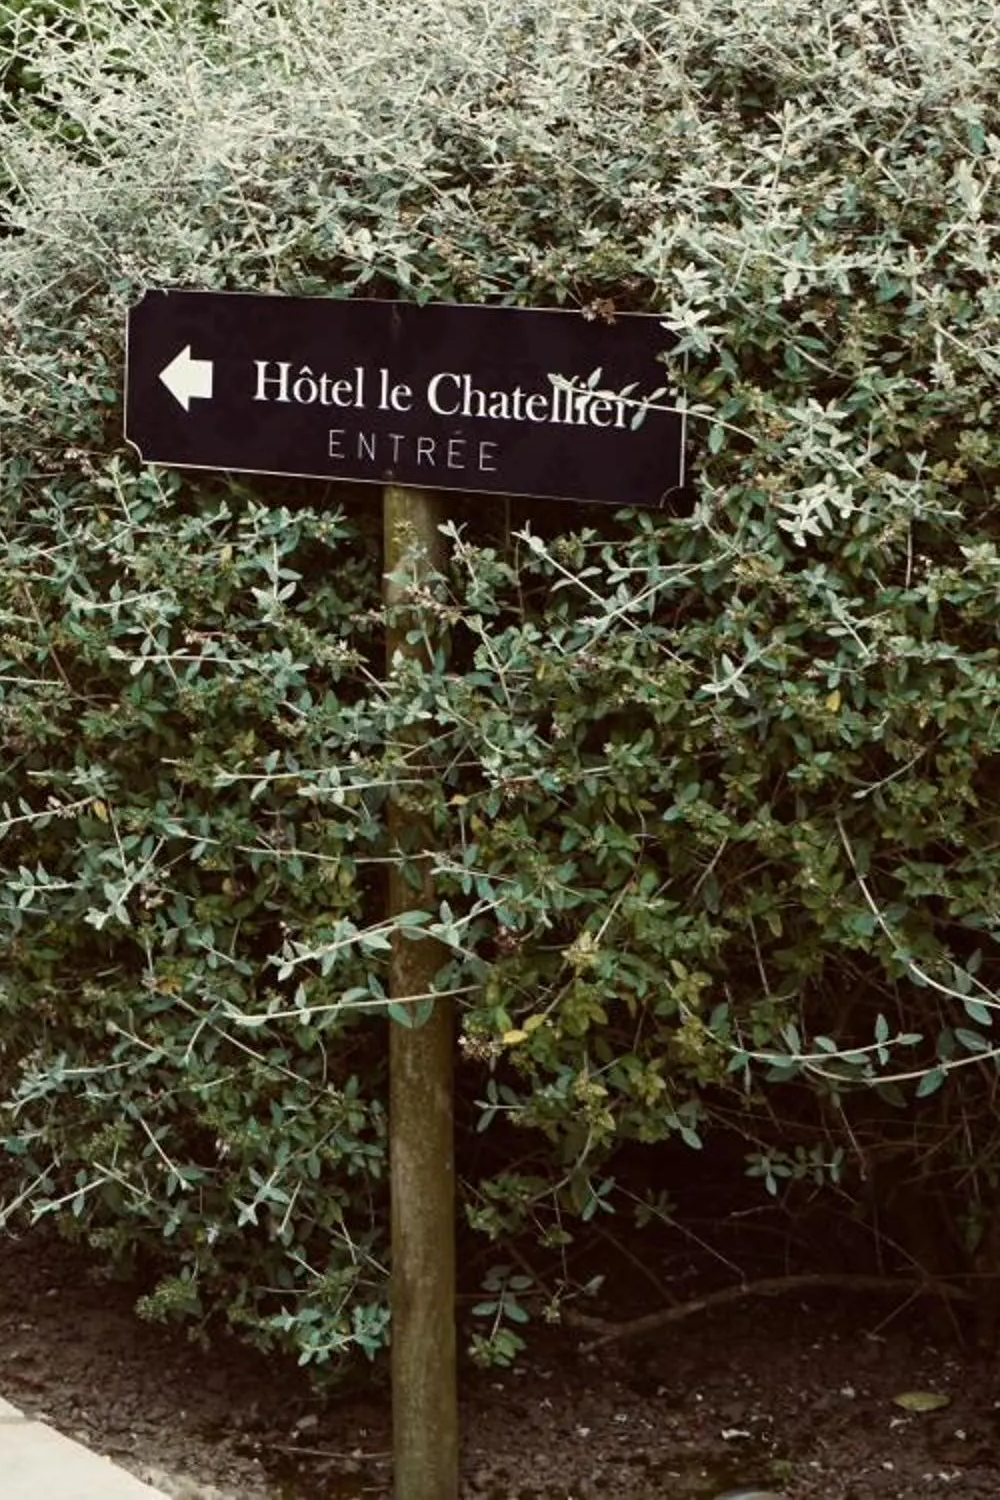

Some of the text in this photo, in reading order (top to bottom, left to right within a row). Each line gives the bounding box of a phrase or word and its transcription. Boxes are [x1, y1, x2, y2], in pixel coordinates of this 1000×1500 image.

[253, 359, 366, 408] Hôtel
[377, 368, 413, 412] le
[328, 429, 499, 472] ENTRÉE
